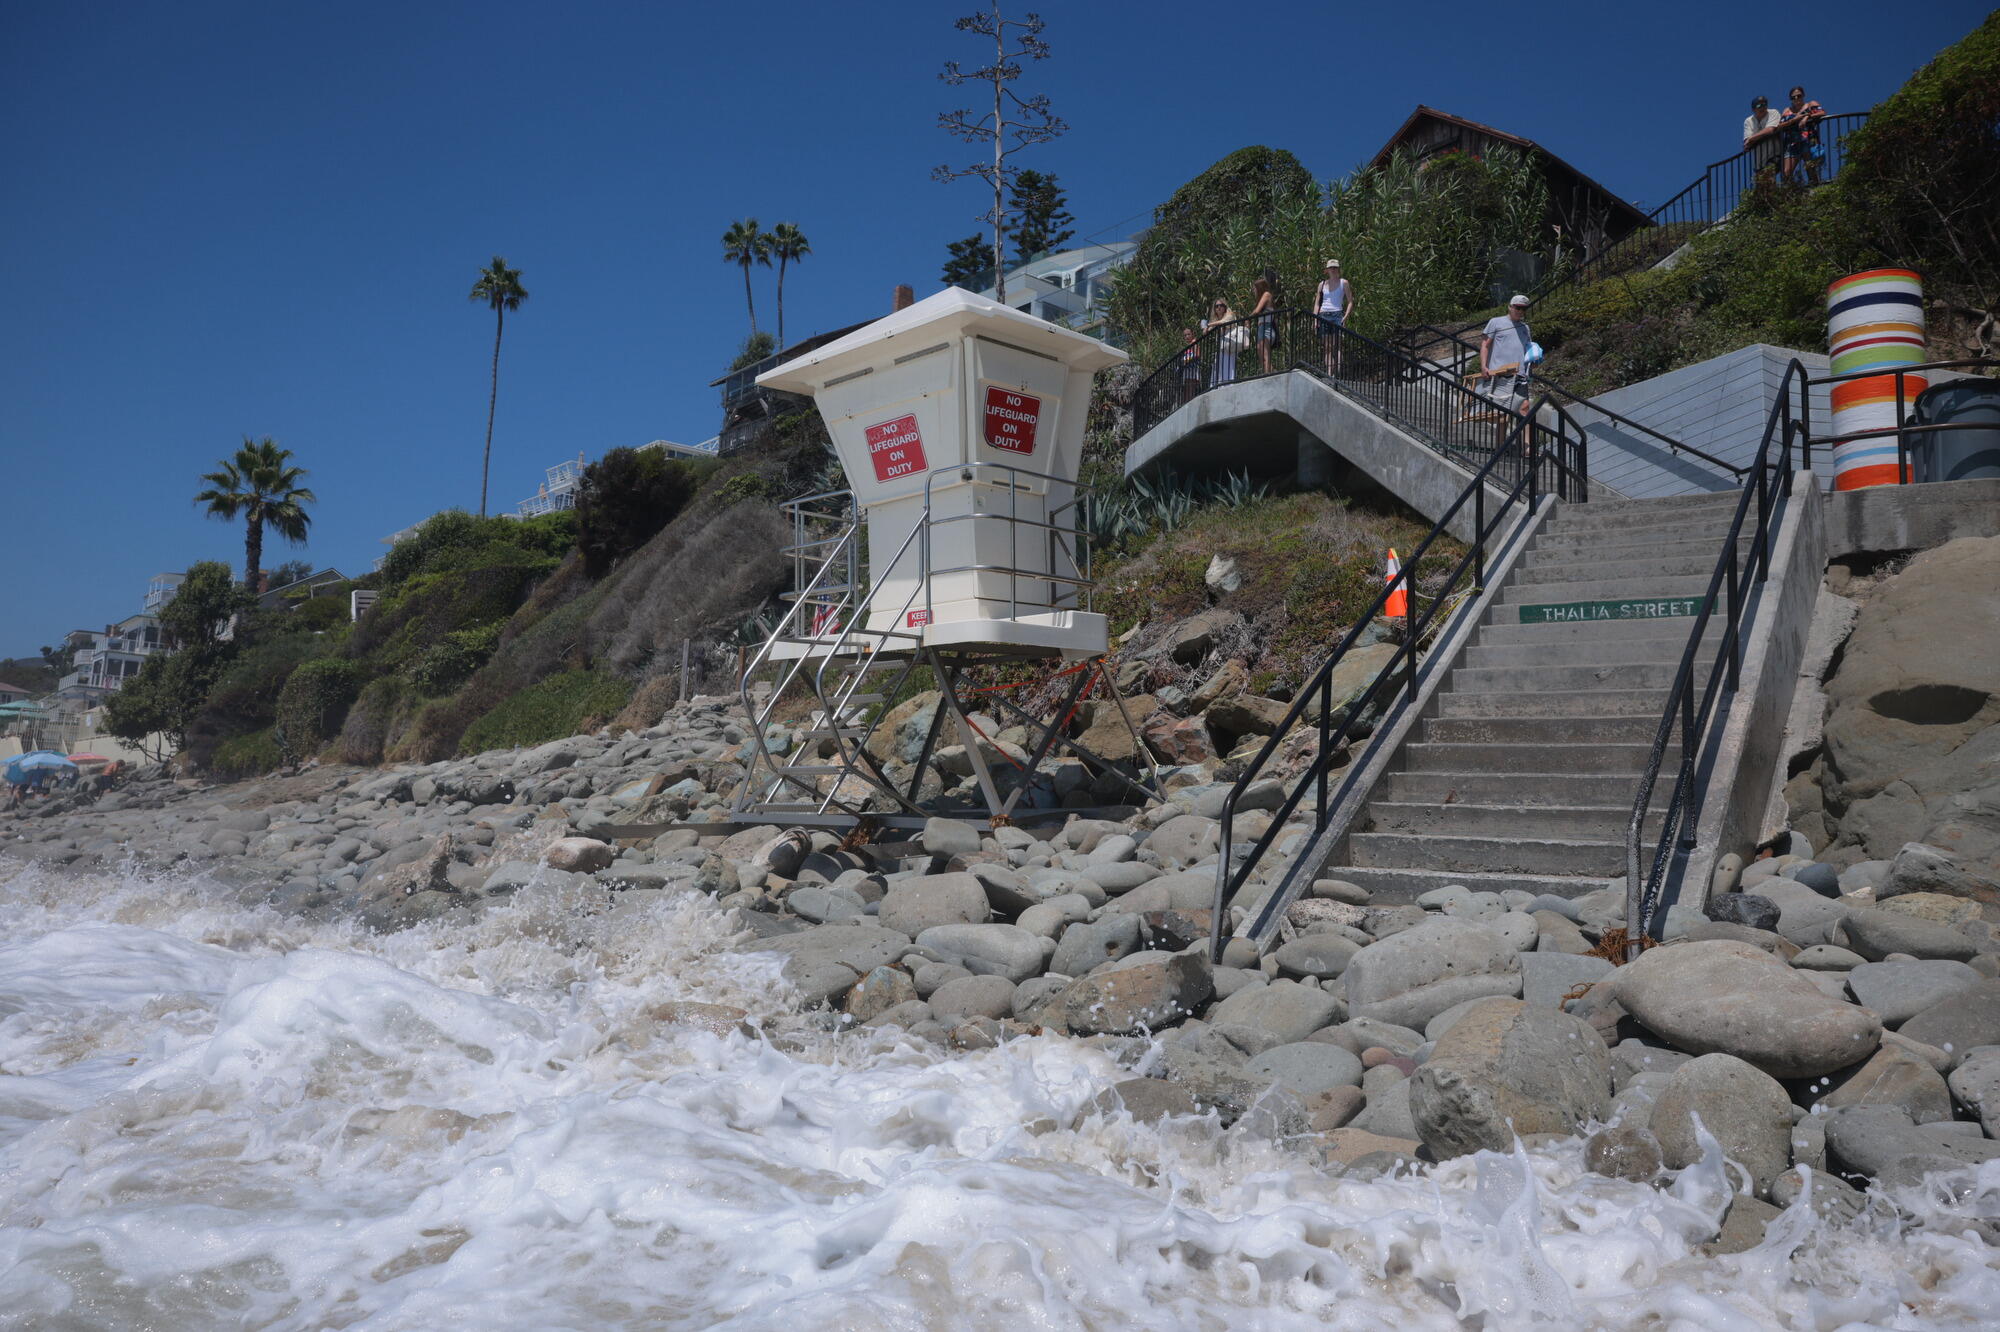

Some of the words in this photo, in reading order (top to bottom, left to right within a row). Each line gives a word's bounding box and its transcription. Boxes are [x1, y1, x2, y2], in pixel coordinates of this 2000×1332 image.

[1006, 395, 1021, 406] NO
[986, 405, 1037, 424] LIFEGUARD
[883, 424, 898, 435] NO
[1002, 423, 1018, 434] ON
[870, 432, 918, 453] LIFEGUARD
[995, 435, 1021, 448] DUTY
[890, 450, 905, 461] ON
[888, 462, 912, 476] DUTY
[1543, 605, 1610, 621] THALIA
[1620, 601, 1694, 618] STREET
